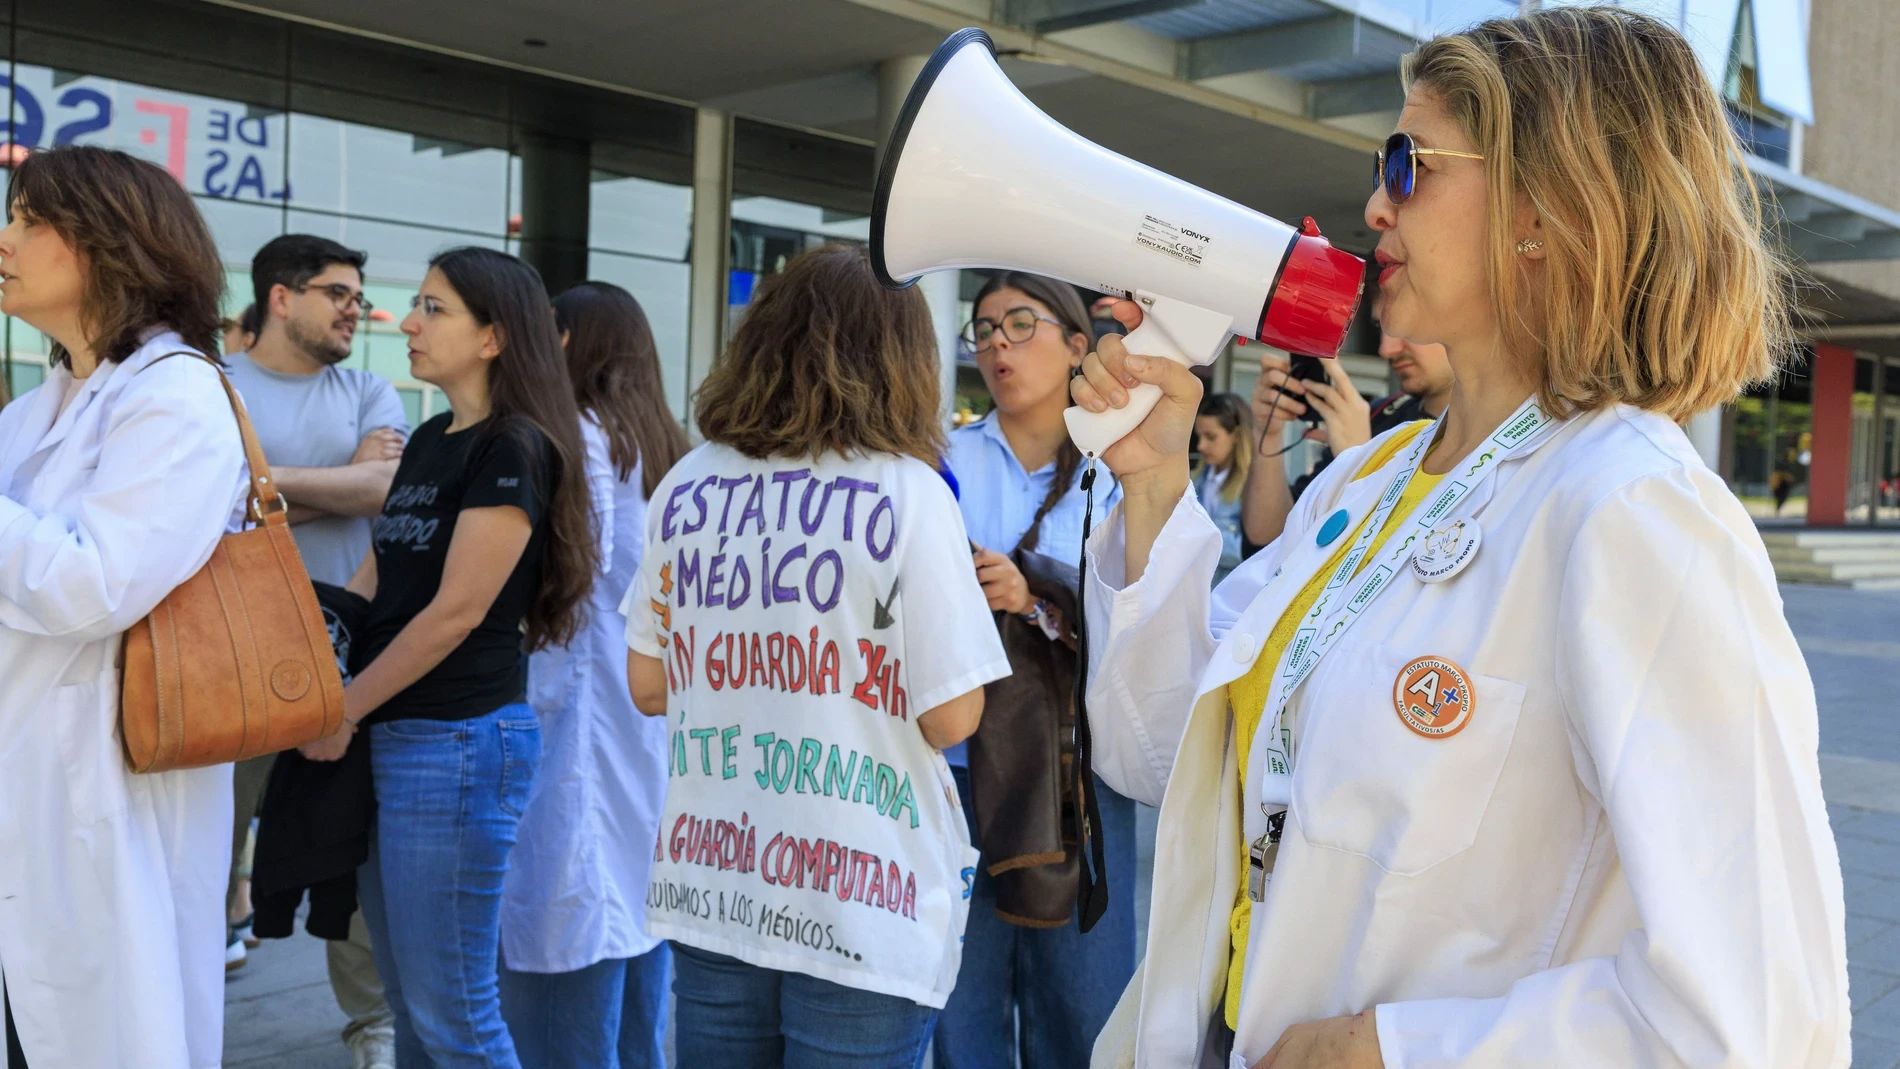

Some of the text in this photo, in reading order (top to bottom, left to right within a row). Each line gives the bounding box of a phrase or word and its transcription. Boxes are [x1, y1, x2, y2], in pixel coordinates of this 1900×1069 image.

[1137, 237, 1201, 264] VONYXAUDIO.COM
[1181, 227, 1210, 243] VONYX
[1503, 412, 1535, 438] ESTATUTO
[1511, 420, 1538, 440] PROPIO
[662, 469, 896, 562] ESTATUTO
[1427, 489, 1454, 518] ESTATUTO
[1432, 494, 1456, 518] PROPIO
[1413, 539, 1475, 576] ESTATUTO MARCO PROPIO
[678, 537, 844, 613] MÉDICO
[1354, 573, 1381, 603] ESTATUTO
[1360, 578, 1382, 602] PROPIO
[1406, 661, 1469, 712] ESTATUTO MARCO PROPIO
[1398, 700, 1444, 734] FACULTATIVOS/AS
[754, 732, 919, 829] JORNADA
[760, 831, 917, 921] COMPUTADA
[646, 878, 711, 920] UIDAMOS
[718, 891, 726, 924] A
[730, 890, 753, 927] LOS
